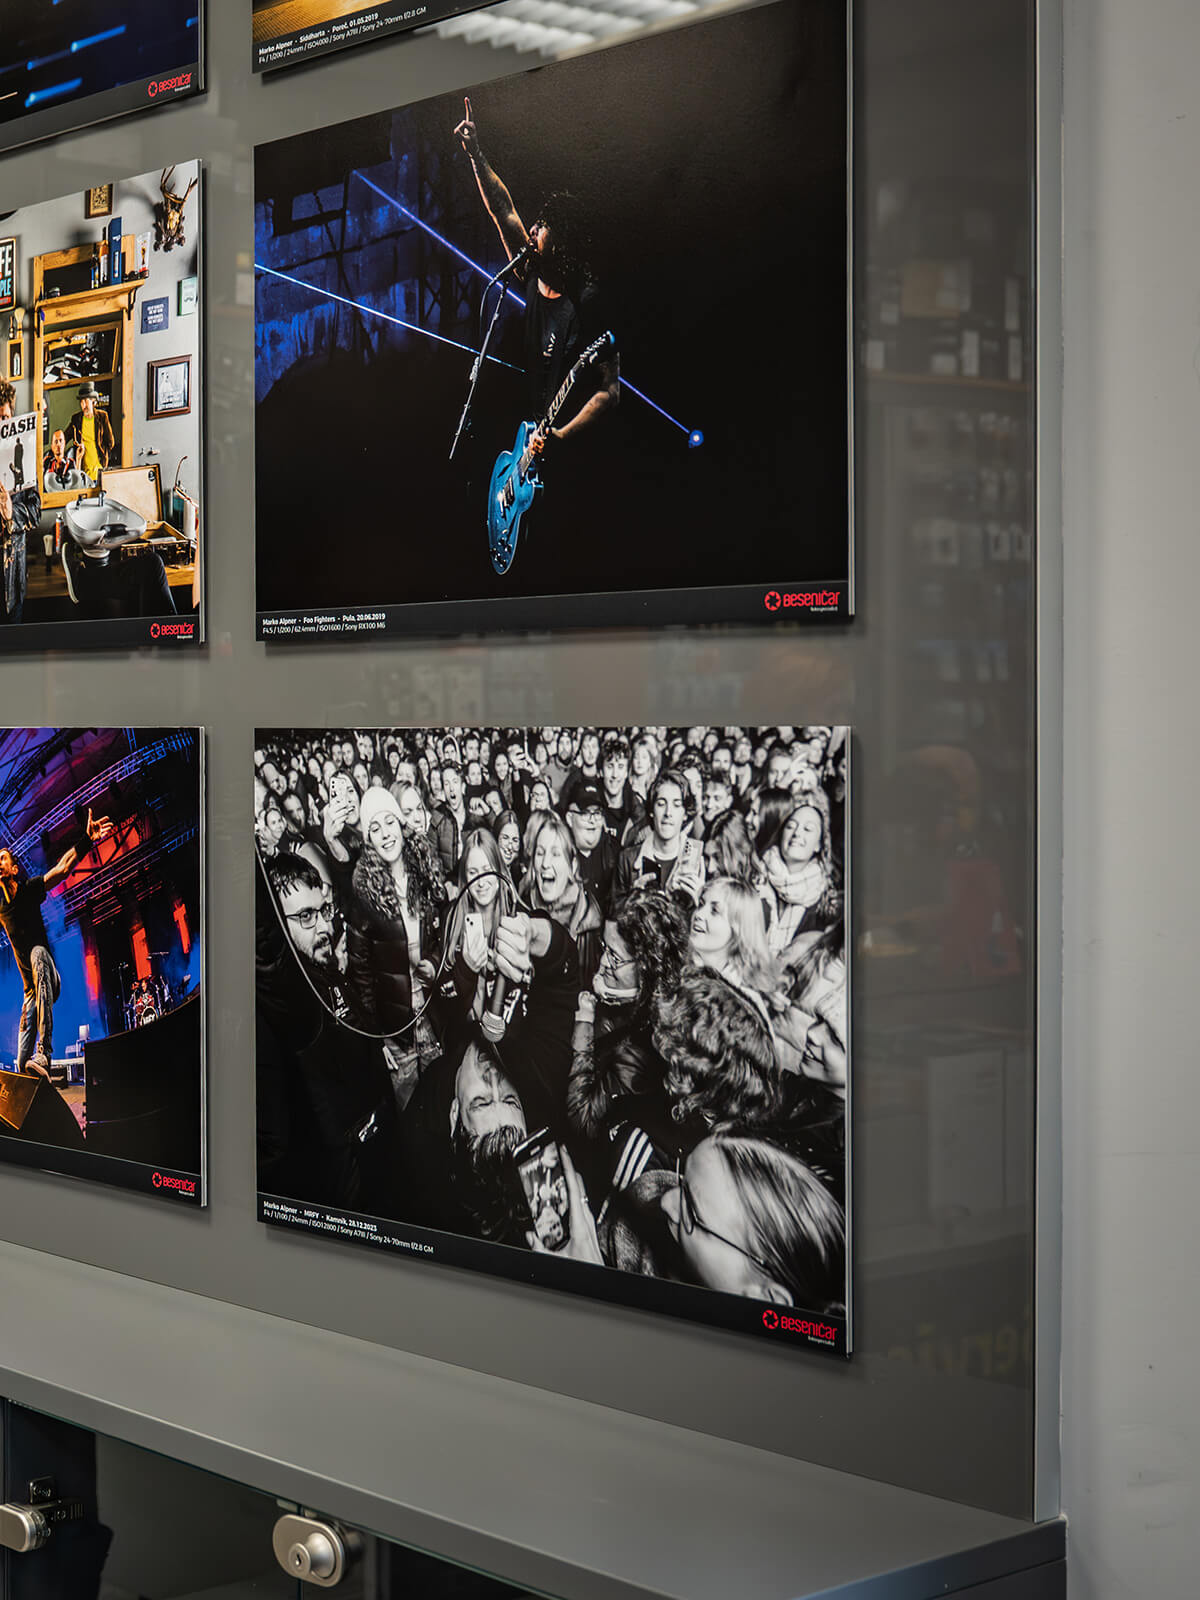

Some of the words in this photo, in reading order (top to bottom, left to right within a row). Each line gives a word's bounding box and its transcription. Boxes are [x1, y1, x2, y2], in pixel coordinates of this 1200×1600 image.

[333, 32, 346, 42] Sony
[362, 23, 376, 33] Sony
[416, 6, 426, 16] GM
[259, 46, 275, 55] Marko
[276, 40, 293, 50] Alpner
[300, 30, 325, 43] Siddharta
[0, 416, 37, 439] CASH
[262, 618, 279, 626] Marko
[279, 617, 297, 626] Alpner
[303, 616, 314, 624] Foo
[314, 615, 336, 625] Fighters
[345, 622, 358, 632] Sony
[263, 1200, 279, 1210] Marko
[279, 1204, 298, 1215] Alpner
[340, 1226, 353, 1237] Sony
[369, 1232, 383, 1243] Sony
[423, 1245, 434, 1254] GM
